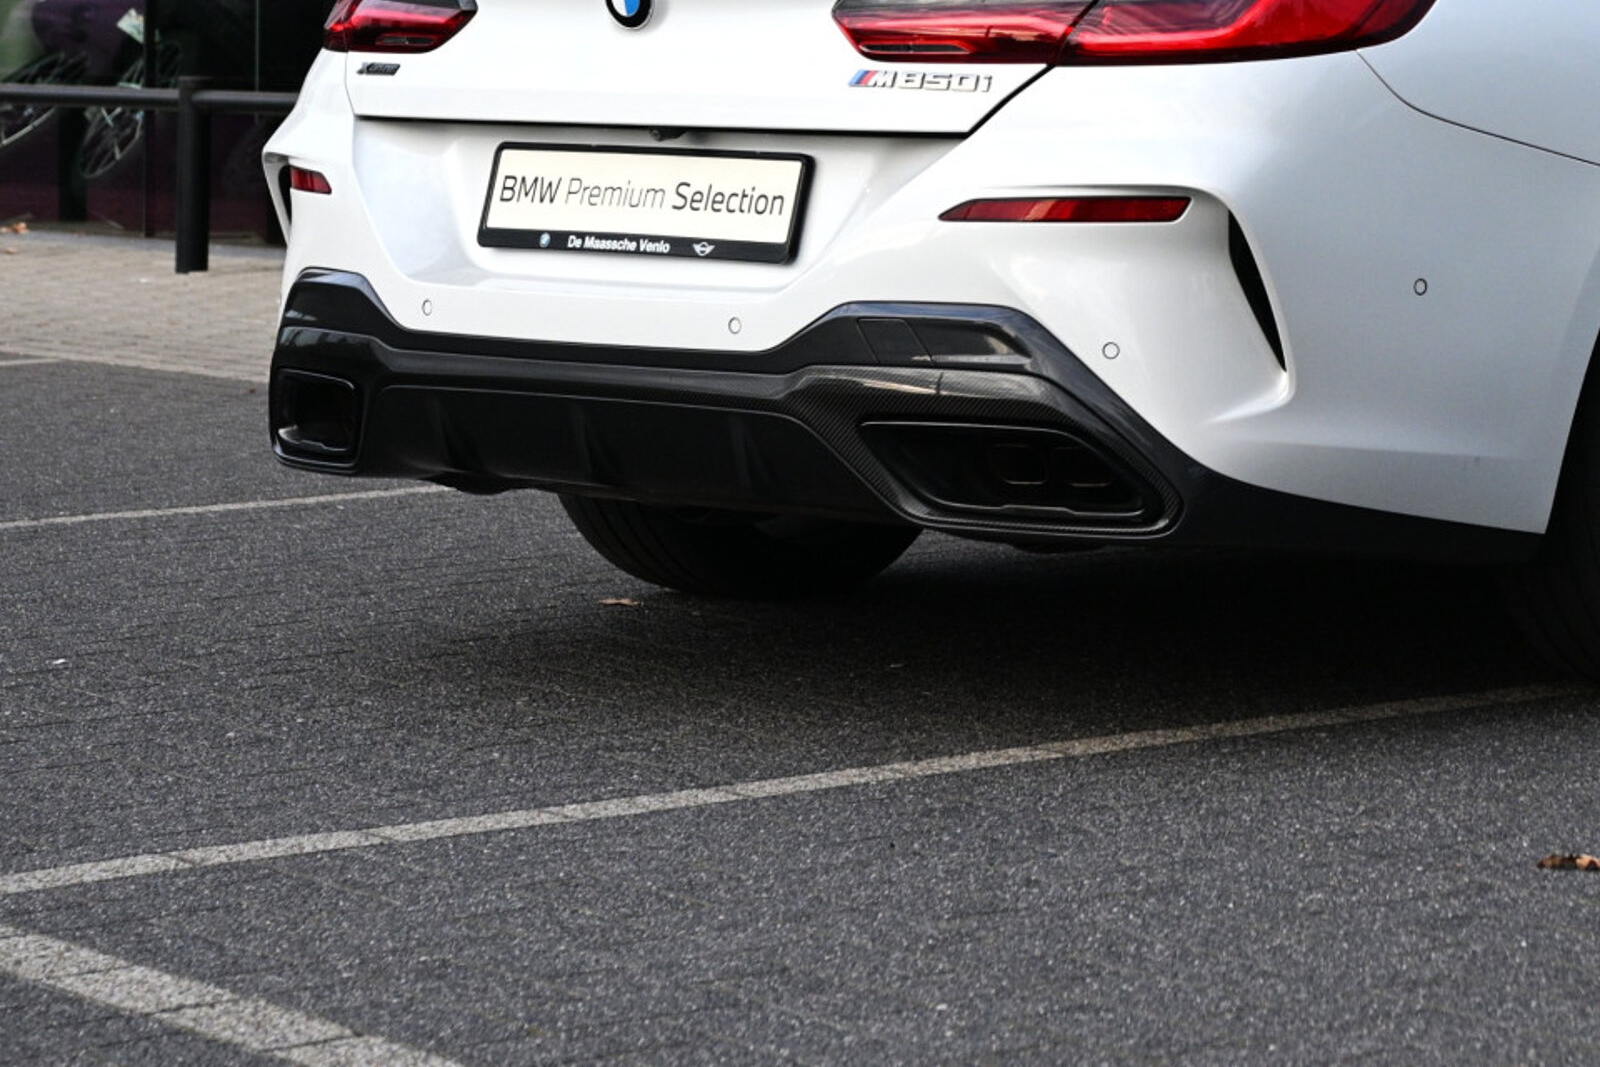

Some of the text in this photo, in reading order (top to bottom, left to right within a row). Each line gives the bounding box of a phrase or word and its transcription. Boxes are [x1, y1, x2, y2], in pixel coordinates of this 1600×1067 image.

[500, 175, 785, 215] BMW Premium Selection
[567, 235, 671, 253] De Maassche Venlo
